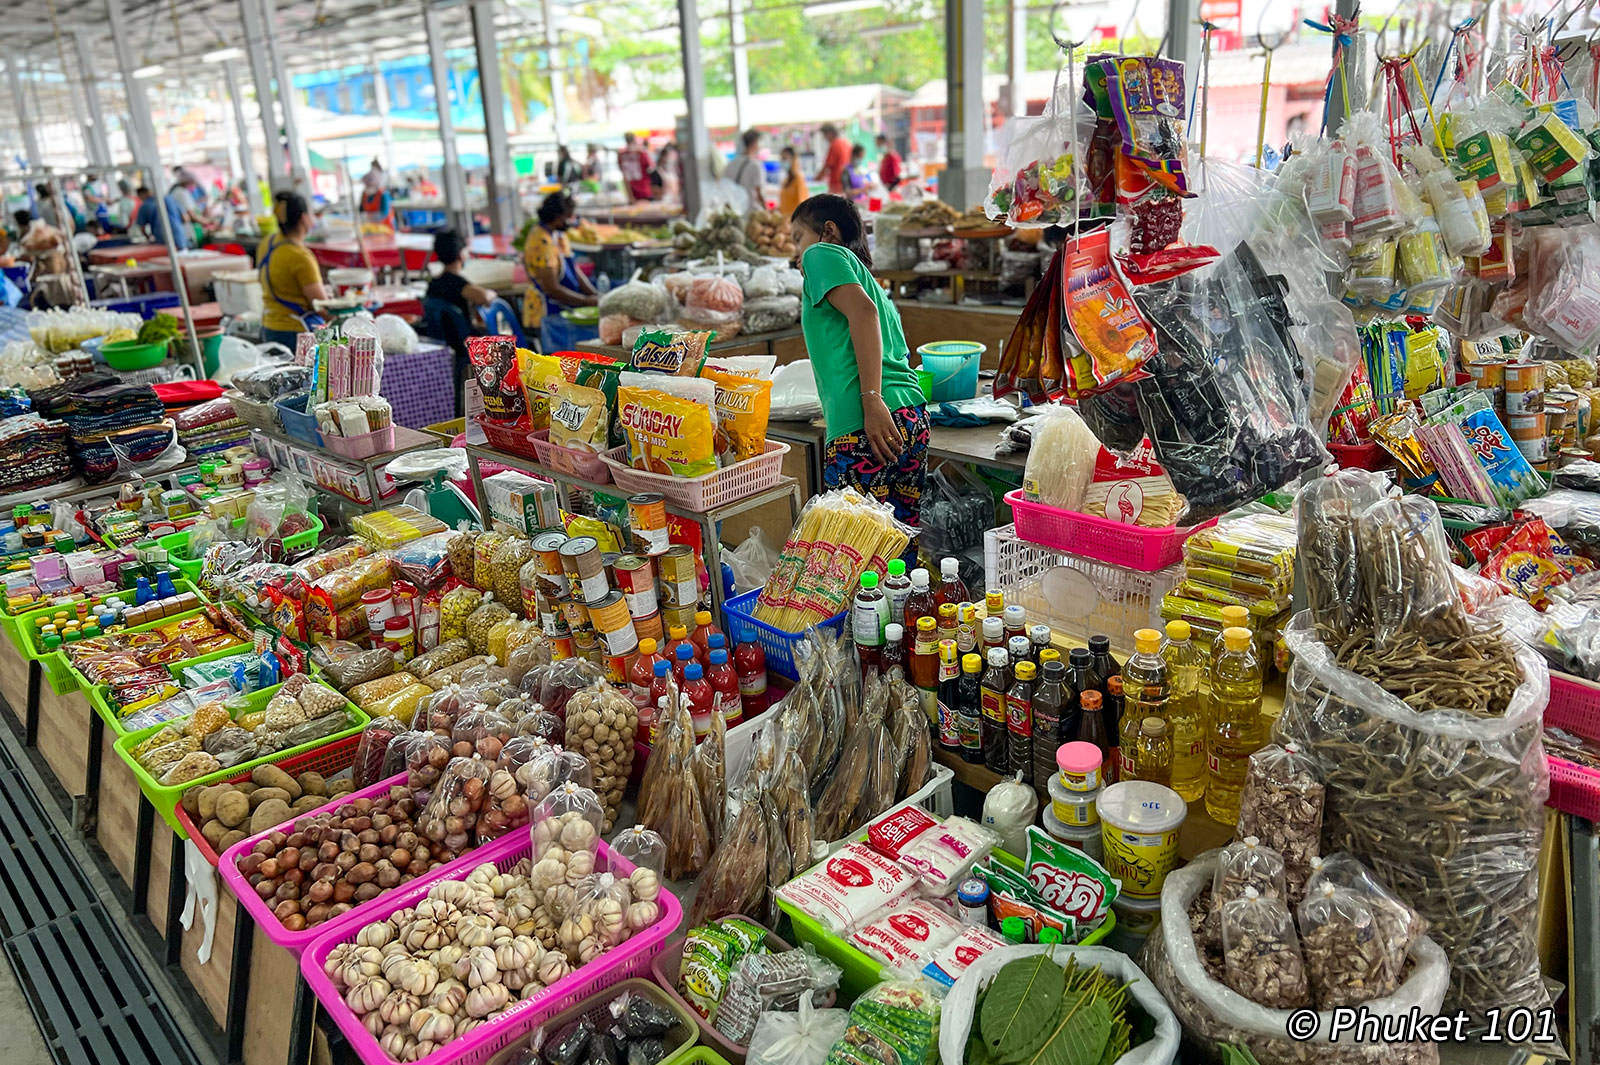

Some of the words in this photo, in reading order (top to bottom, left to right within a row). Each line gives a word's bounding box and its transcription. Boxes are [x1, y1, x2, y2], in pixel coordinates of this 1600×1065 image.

[715, 386, 750, 412] TINUM
[621, 403, 684, 439] SUNDAY
[633, 431, 650, 443] TEA
[650, 435, 668, 448] MIX
[525, 503, 539, 531] yal-D
[1030, 864, 1103, 919] รสดี
